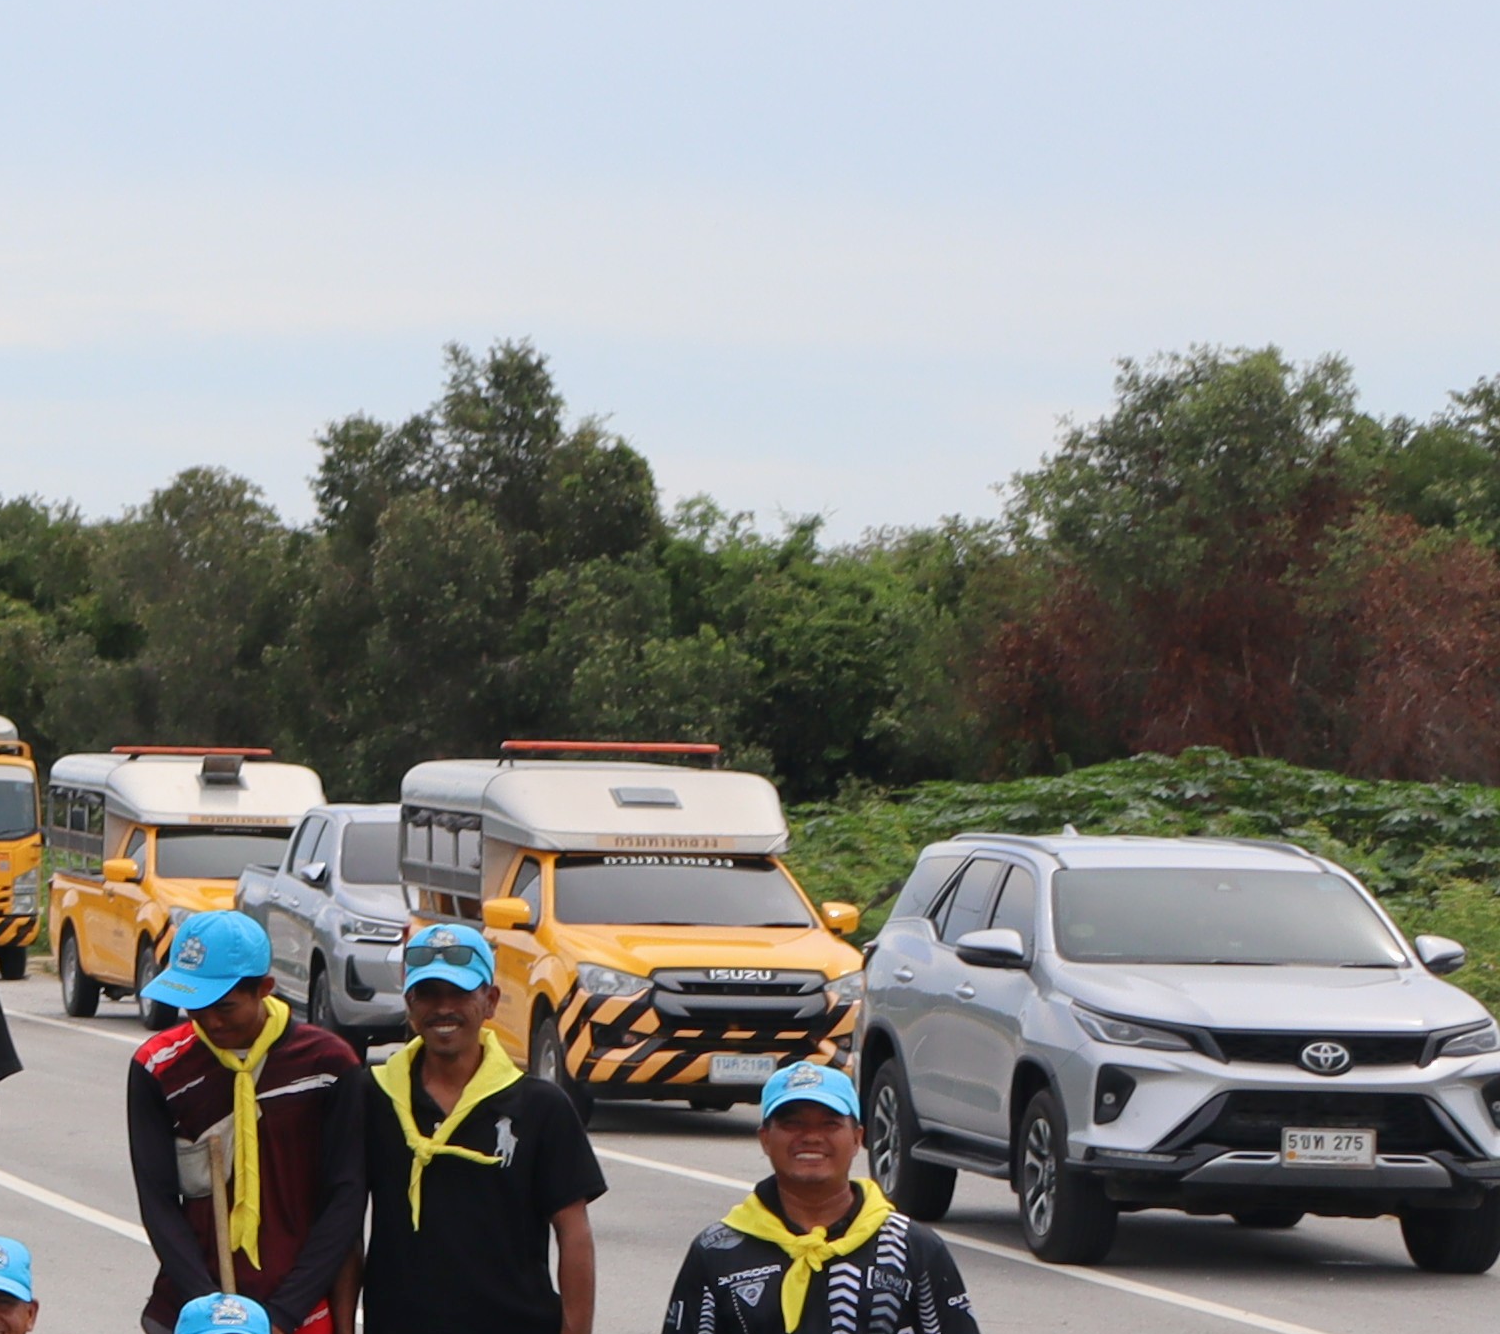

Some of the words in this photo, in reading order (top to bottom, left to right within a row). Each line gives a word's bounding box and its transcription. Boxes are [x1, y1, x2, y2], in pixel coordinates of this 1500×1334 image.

[614, 836, 719, 848] กรมทางหลวง
[602, 855, 734, 868] กรมทางหลวง
[709, 969, 772, 980] ISUZU
[1332, 1135, 1364, 1151] 275
